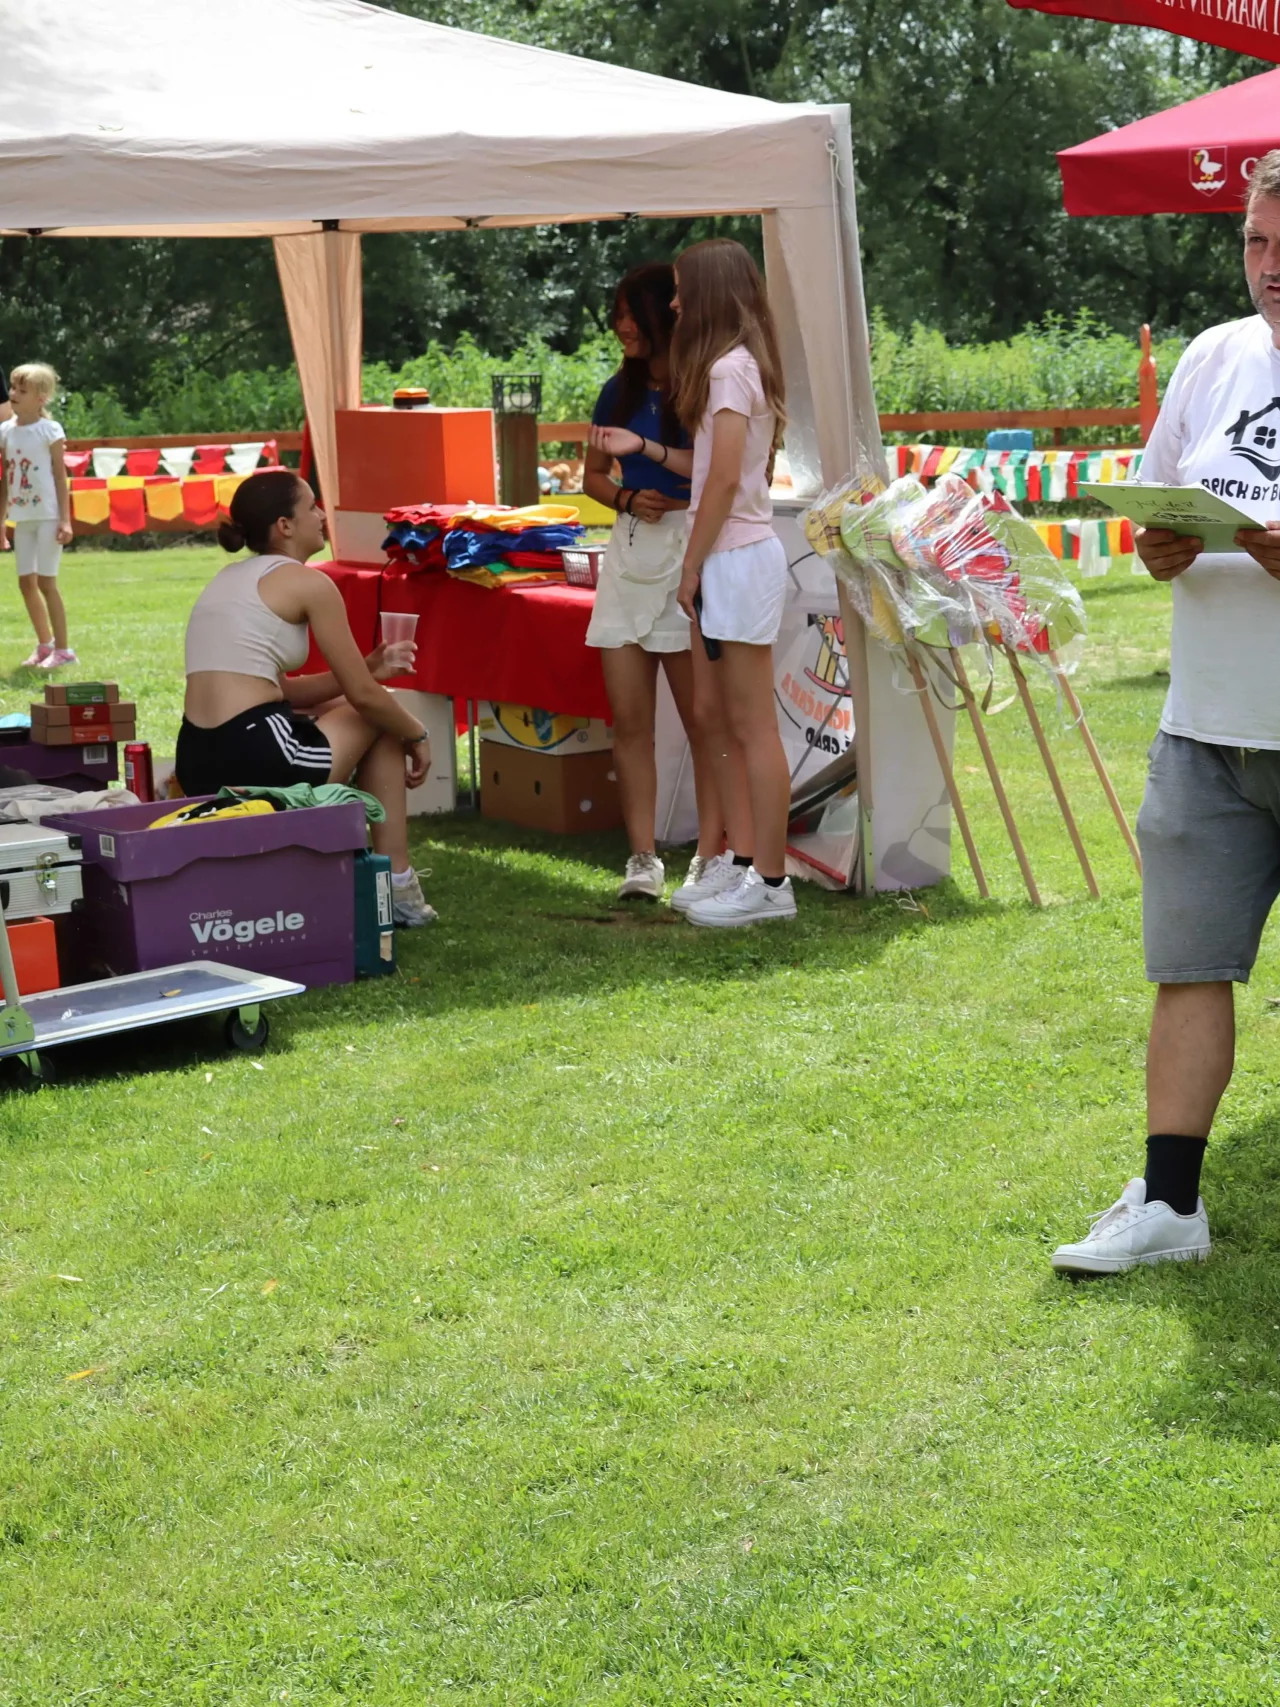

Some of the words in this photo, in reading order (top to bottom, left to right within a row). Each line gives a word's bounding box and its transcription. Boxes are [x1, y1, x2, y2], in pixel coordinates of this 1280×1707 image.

[1251, 486, 1270, 501] BY
[189, 909, 233, 922] Charles
[190, 910, 305, 943] Vögele
